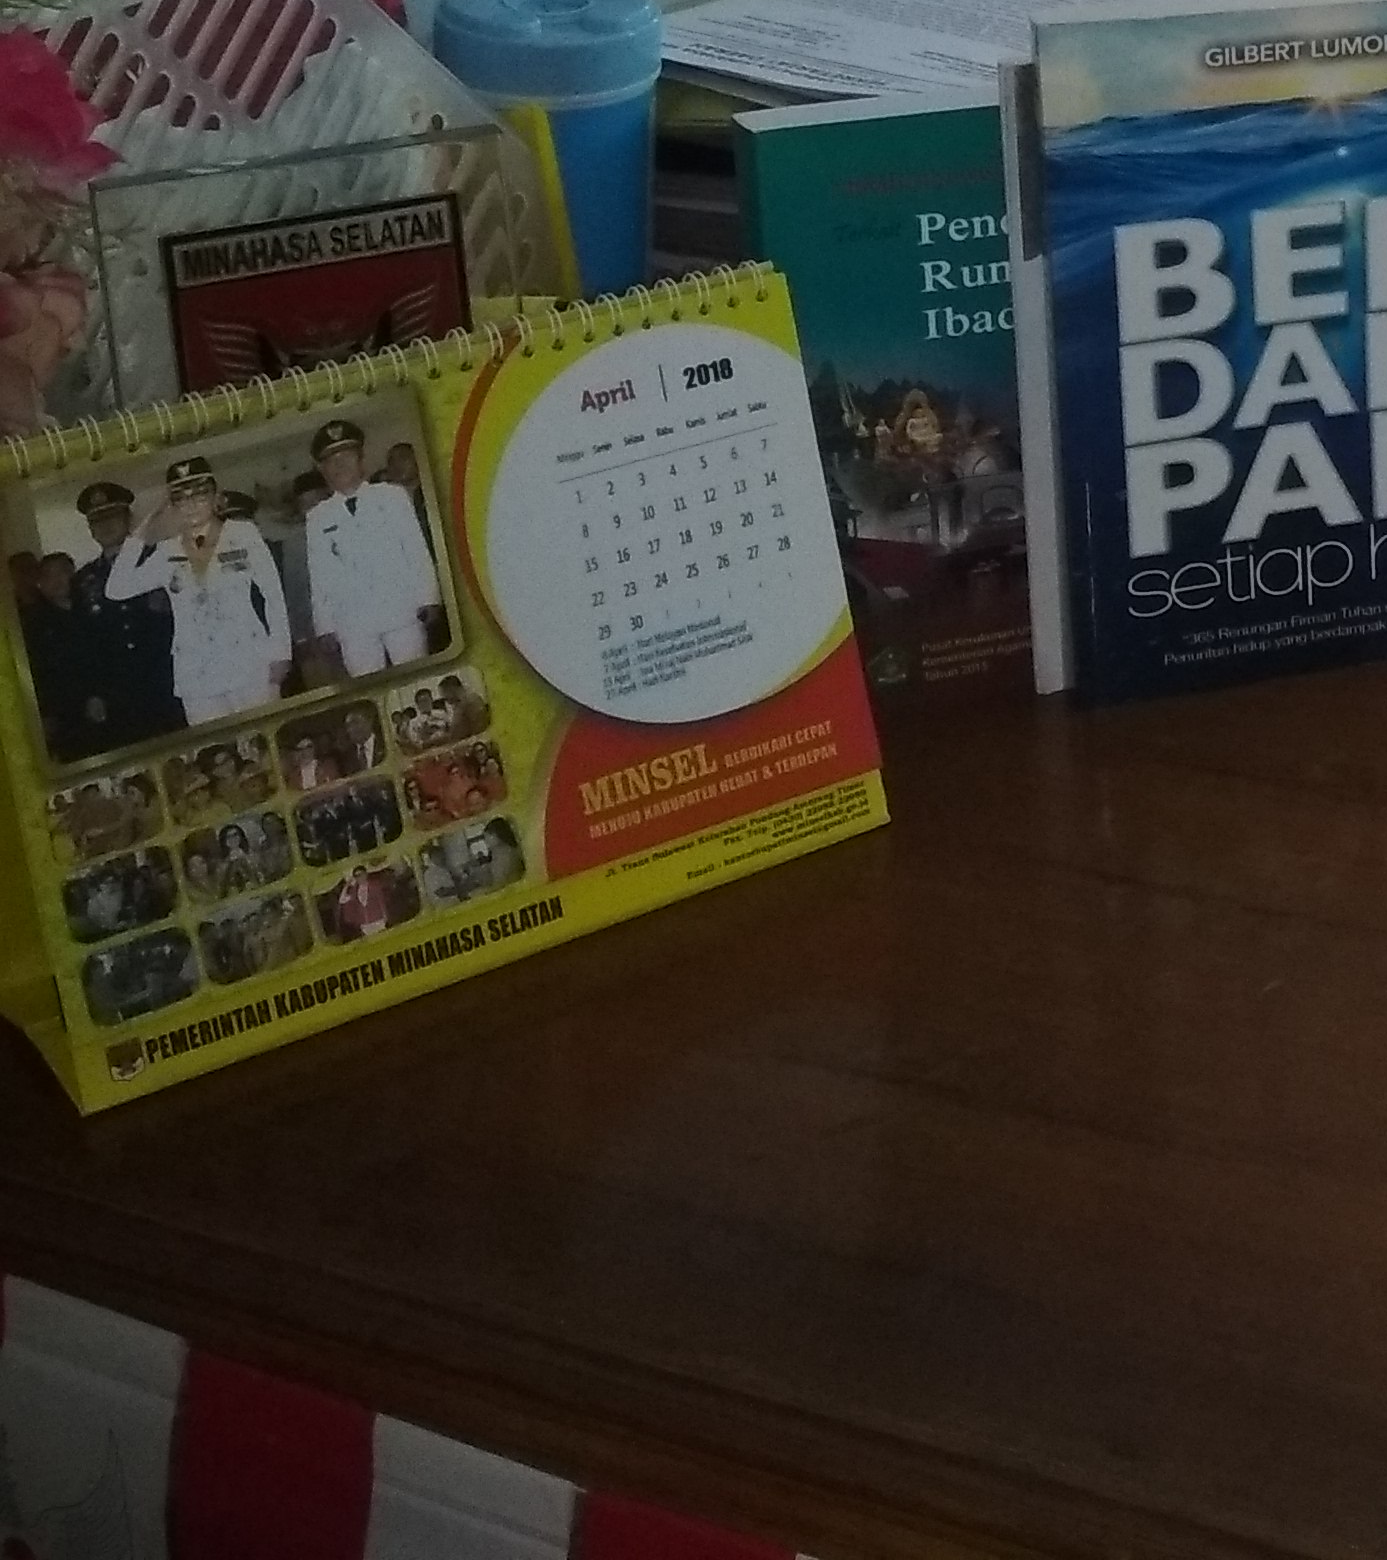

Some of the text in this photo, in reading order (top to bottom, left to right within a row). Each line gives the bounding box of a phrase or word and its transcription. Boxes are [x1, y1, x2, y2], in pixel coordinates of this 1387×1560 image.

[1204, 40, 1305, 68] GILBERT
[180, 209, 446, 282] MINAHASA SELATAN
[580, 357, 735, 414] April 2018
[642, 506, 656, 521] 10
[673, 496, 688, 512] 11
[703, 487, 717, 504] 12
[733, 479, 748, 495] 13
[764, 470, 778, 486] 14
[584, 503, 785, 574] 15 16 17 18 19 20 21
[591, 535, 792, 608] 22 23 24 25 26 27 28
[1127, 539, 1355, 619] setiap
[598, 614, 644, 642] 29 30
[1163, 645, 1231, 666] Penuntun
[1232, 638, 1273, 658] hidup
[1274, 631, 1309, 651] yang
[1310, 618, 1387, 641] berdampak
[1217, 618, 1288, 642] Renungan
[1290, 610, 1337, 629] Firman
[1340, 603, 1382, 621] Tuhan
[577, 720, 833, 817] MINSEL BERDIKARI CEPAT
[643, 781, 718, 821] KABUPATEN
[762, 764, 774, 781] &
[775, 743, 839, 775] TERDEPAN
[145, 895, 565, 1065] PEMERINTAH KABUPATEN MINAHASA SELATAN
